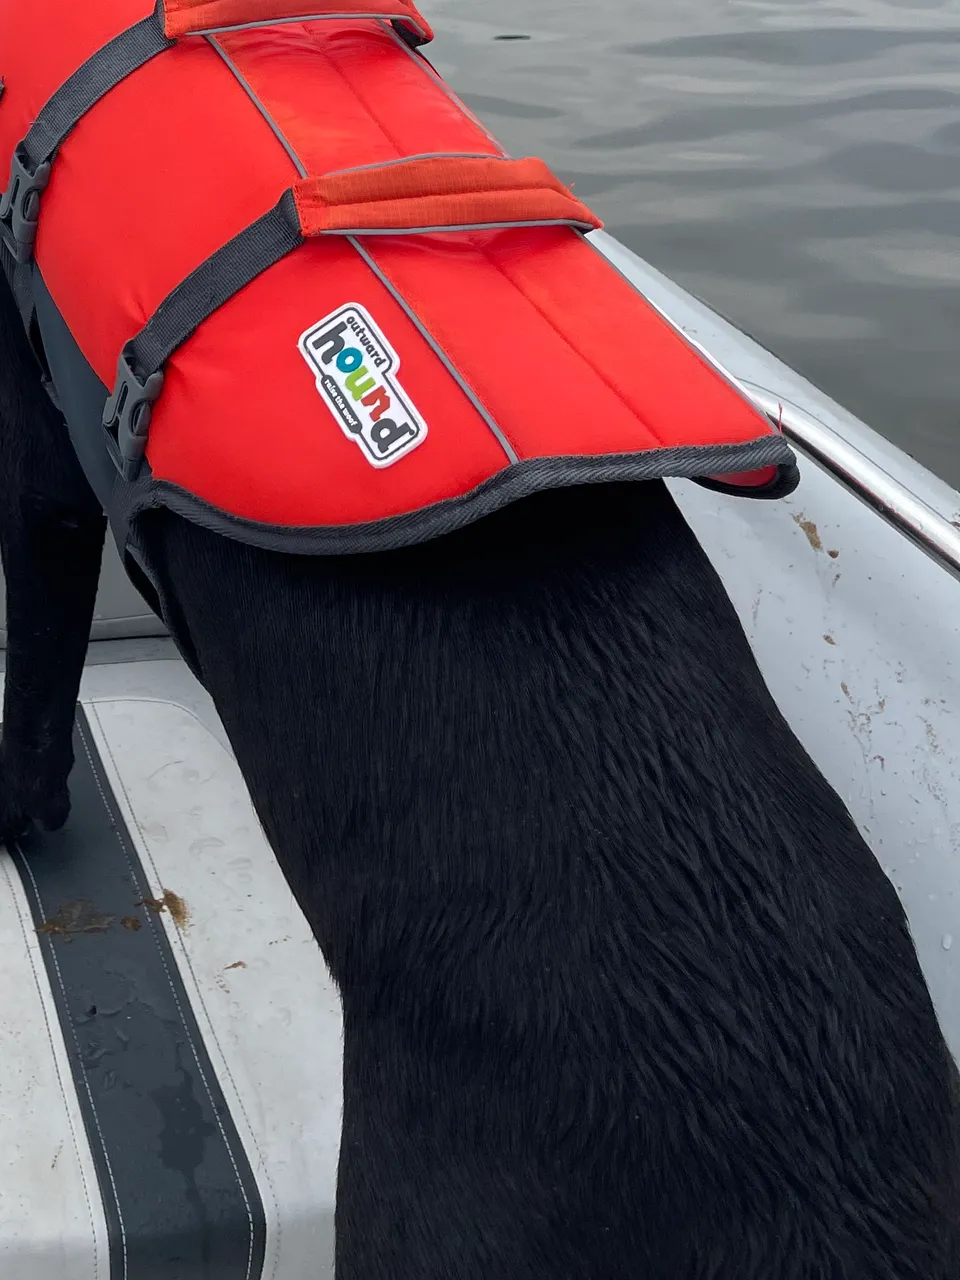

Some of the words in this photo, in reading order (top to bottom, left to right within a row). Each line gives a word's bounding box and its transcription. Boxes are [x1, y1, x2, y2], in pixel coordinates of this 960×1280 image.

[346, 316, 387, 368] outward
[312, 321, 410, 454] hound
[324, 379, 338, 398] raise
[335, 395, 345, 410] the
[342, 407, 358, 426] woof
